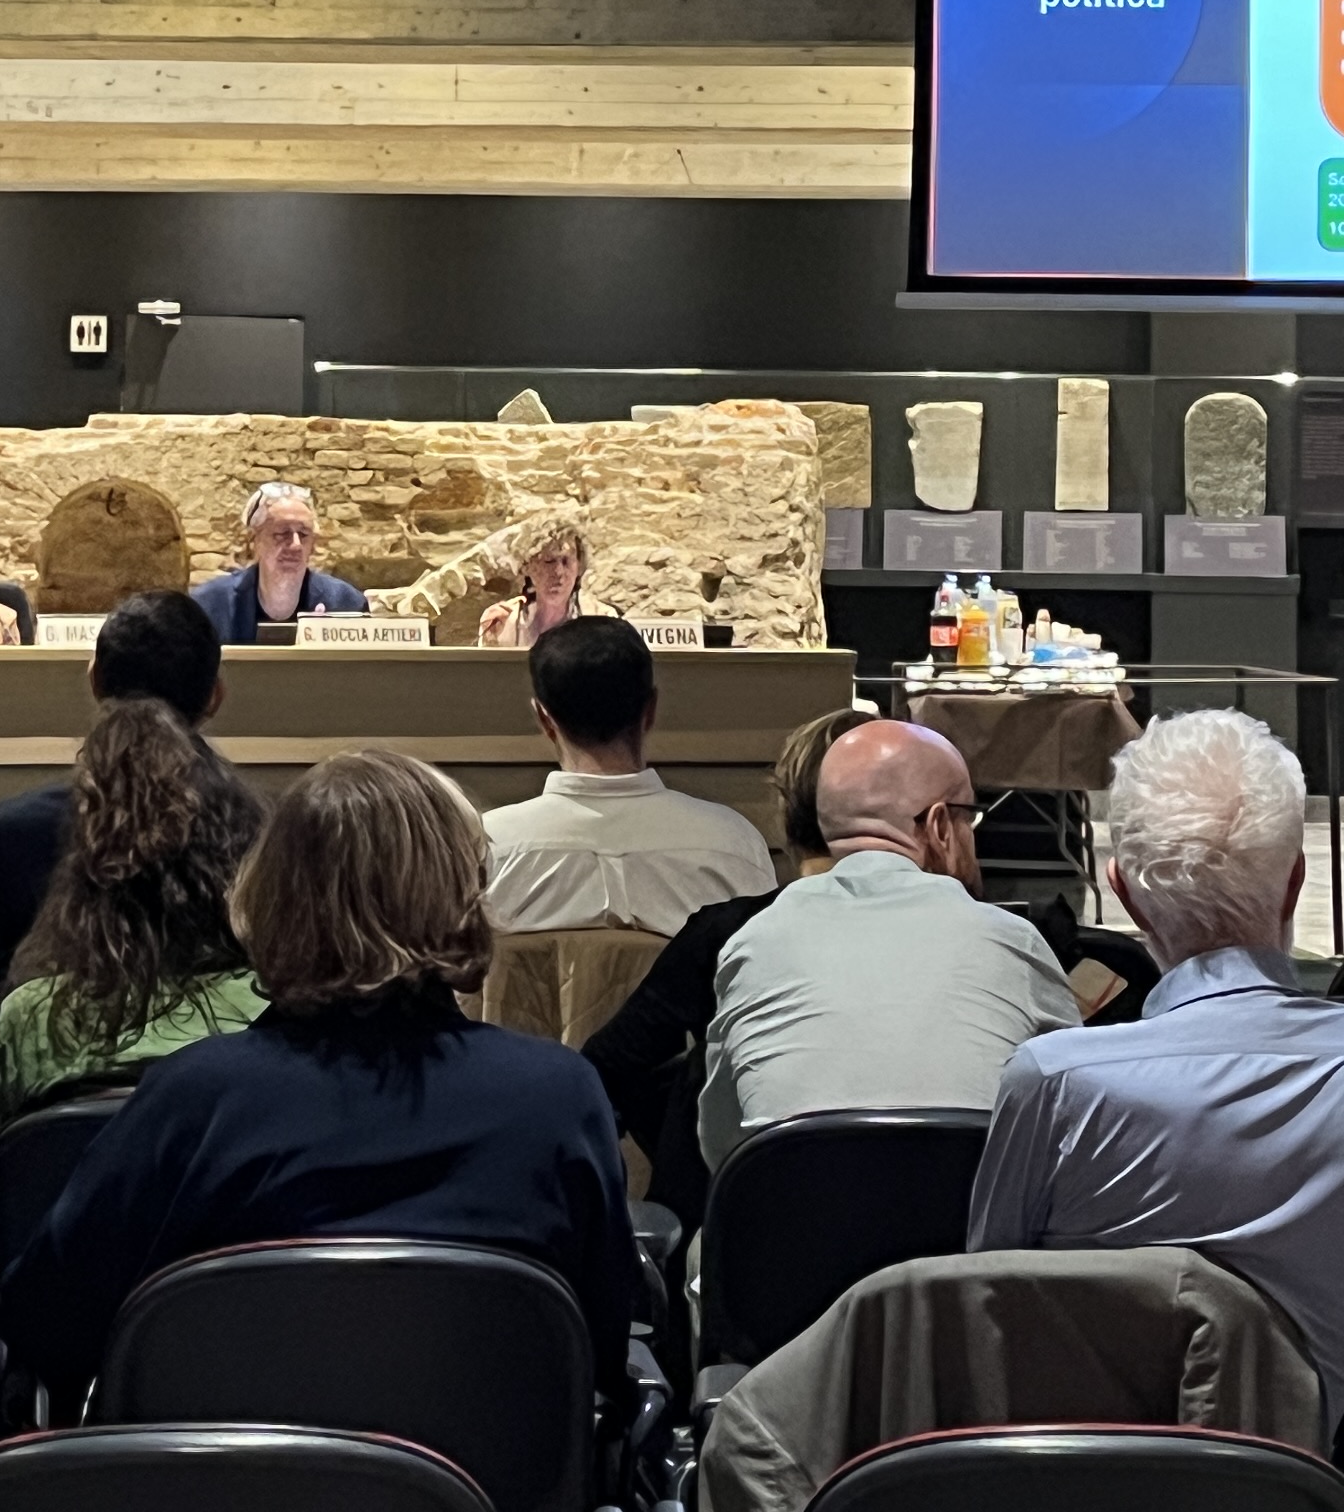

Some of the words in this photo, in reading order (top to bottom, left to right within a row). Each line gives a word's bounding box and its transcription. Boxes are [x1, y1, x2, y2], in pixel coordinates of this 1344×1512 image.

[66, 625, 97, 642] MAS
[322, 627, 369, 642] BOCCIA
[640, 627, 698, 645] IVEGNA
